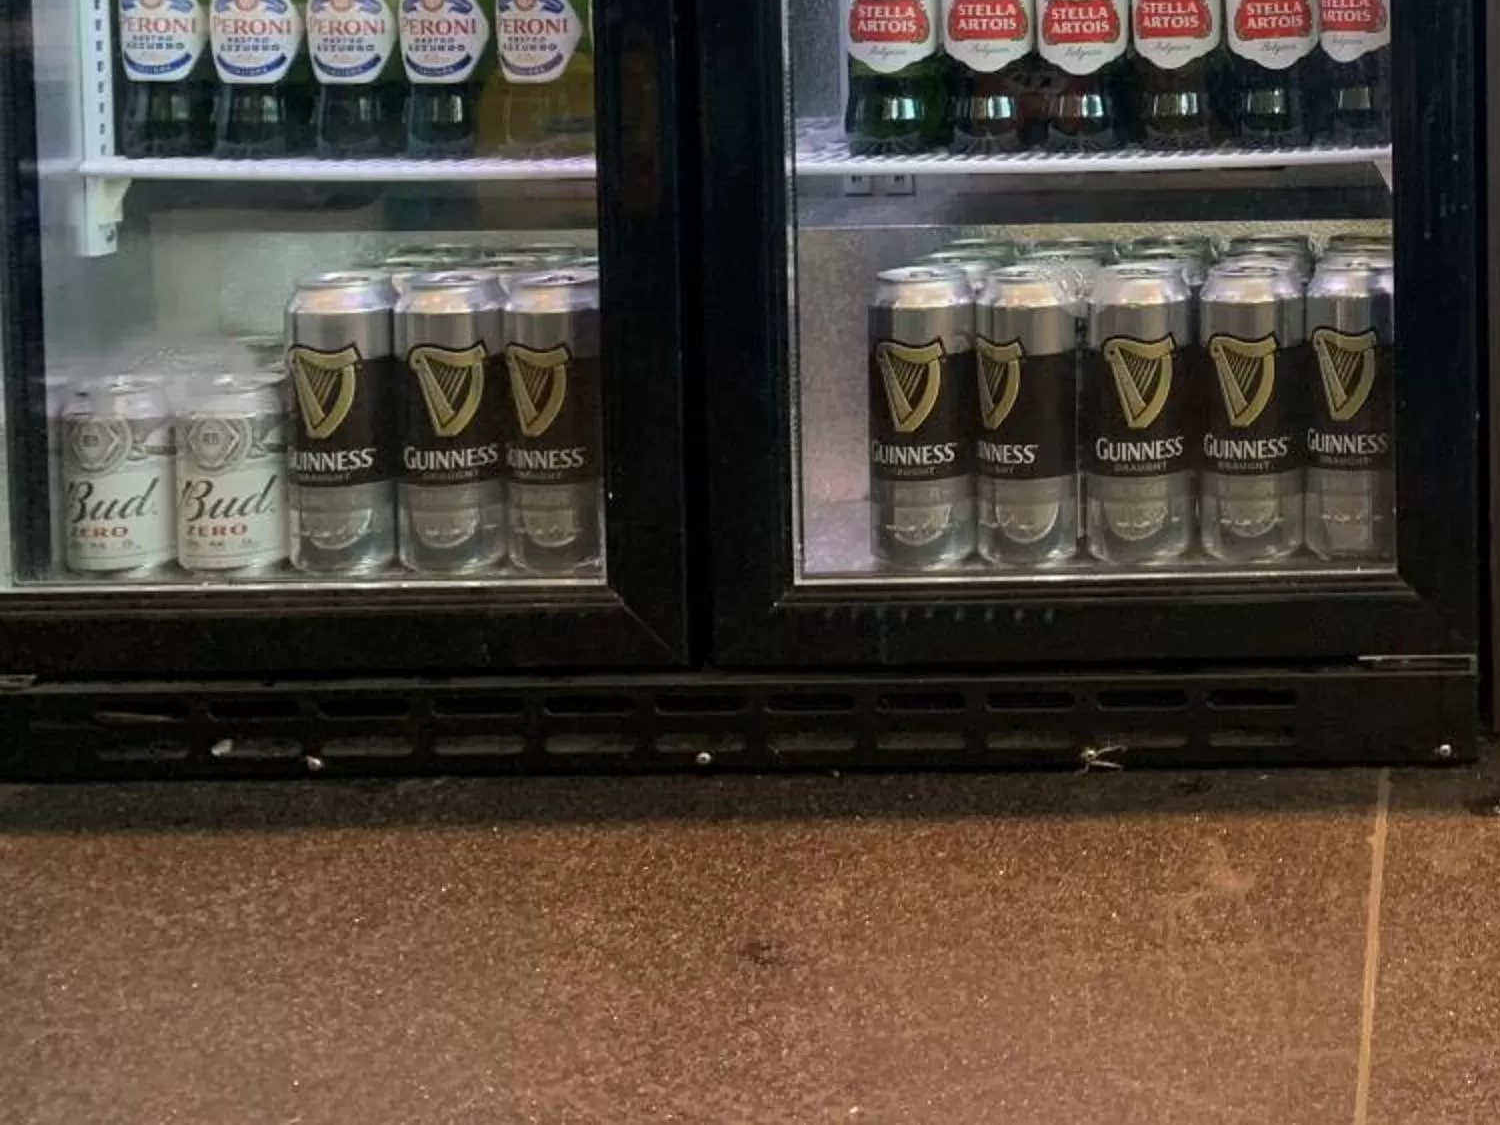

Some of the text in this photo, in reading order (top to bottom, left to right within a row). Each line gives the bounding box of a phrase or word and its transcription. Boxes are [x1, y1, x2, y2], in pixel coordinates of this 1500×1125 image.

[957, 3, 1016, 16] STELLA
[1051, 6, 1109, 20] STELLA
[1141, 2, 1199, 14] STELLA
[1246, 2, 1303, 16] STELLA
[500, 16, 568, 35] ERONI
[871, 439, 958, 465] GUINNESS
[1095, 435, 1184, 463] GUINNESS
[1203, 433, 1290, 461] GUINNESS
[1306, 428, 1389, 455] GUINNESS
[403, 442, 499, 470] GUINNESS
[68, 474, 159, 525] Bud
[178, 473, 278, 522] Bud
